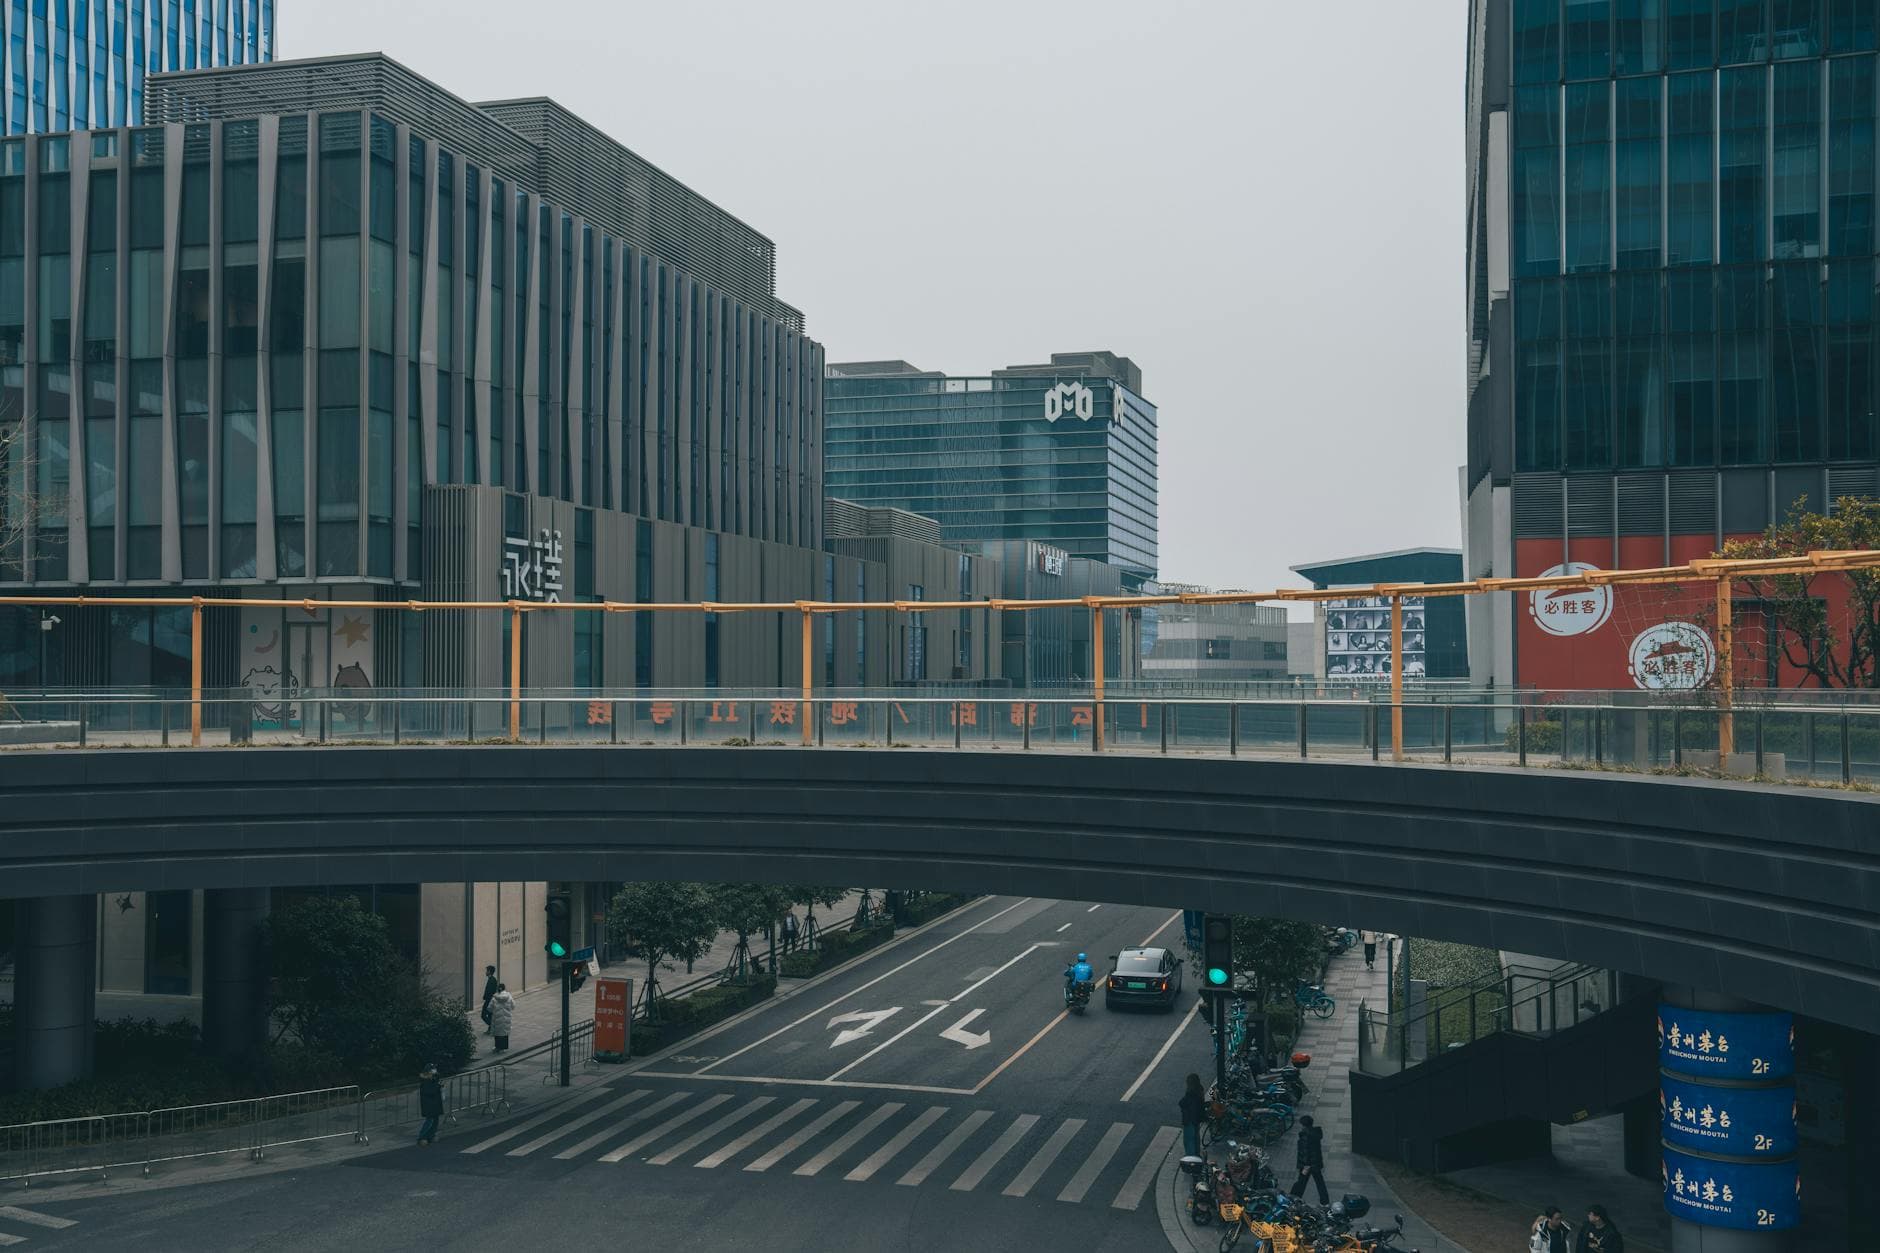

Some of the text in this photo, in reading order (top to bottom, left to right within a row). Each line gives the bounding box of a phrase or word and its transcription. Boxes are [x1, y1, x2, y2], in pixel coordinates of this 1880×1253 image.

[1544, 600, 1596, 615] 必胜客
[1644, 659, 1698, 675] 必胜客
[1698, 1055, 1727, 1063] MOUTAI
[1752, 1058, 1770, 1074] 2F
[1700, 1130, 1729, 1139] MOUTAI
[1754, 1134, 1772, 1150] 2F
[1703, 1203, 1732, 1213] MOUTAI
[1757, 1209, 1775, 1225] 2F
